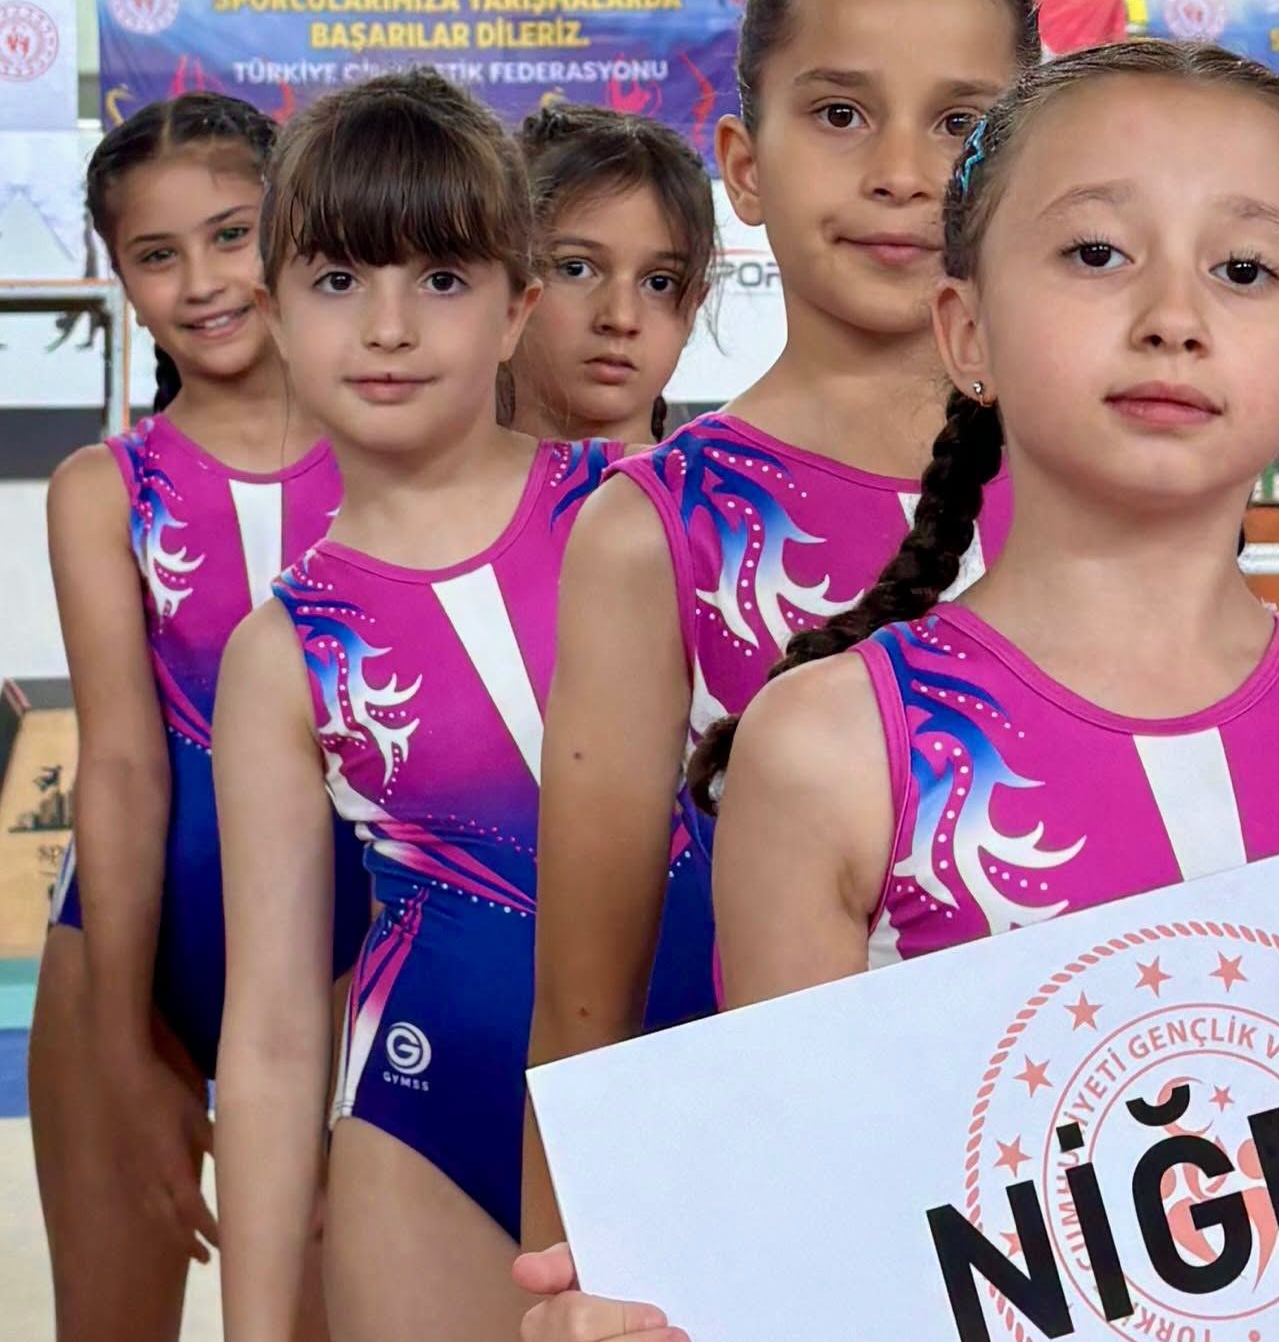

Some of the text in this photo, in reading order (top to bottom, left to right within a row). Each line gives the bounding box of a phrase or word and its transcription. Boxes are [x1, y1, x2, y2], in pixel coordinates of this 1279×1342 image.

[310, 16, 591, 52] BAŞARILAR DİLERİZ.
[233, 60, 337, 83] TÜRKİYE
[489, 59, 668, 83] FEDERASYONU
[1127, 1014, 1259, 1060] GENÇLİK
[382, 1070, 430, 1092] GYMSS
